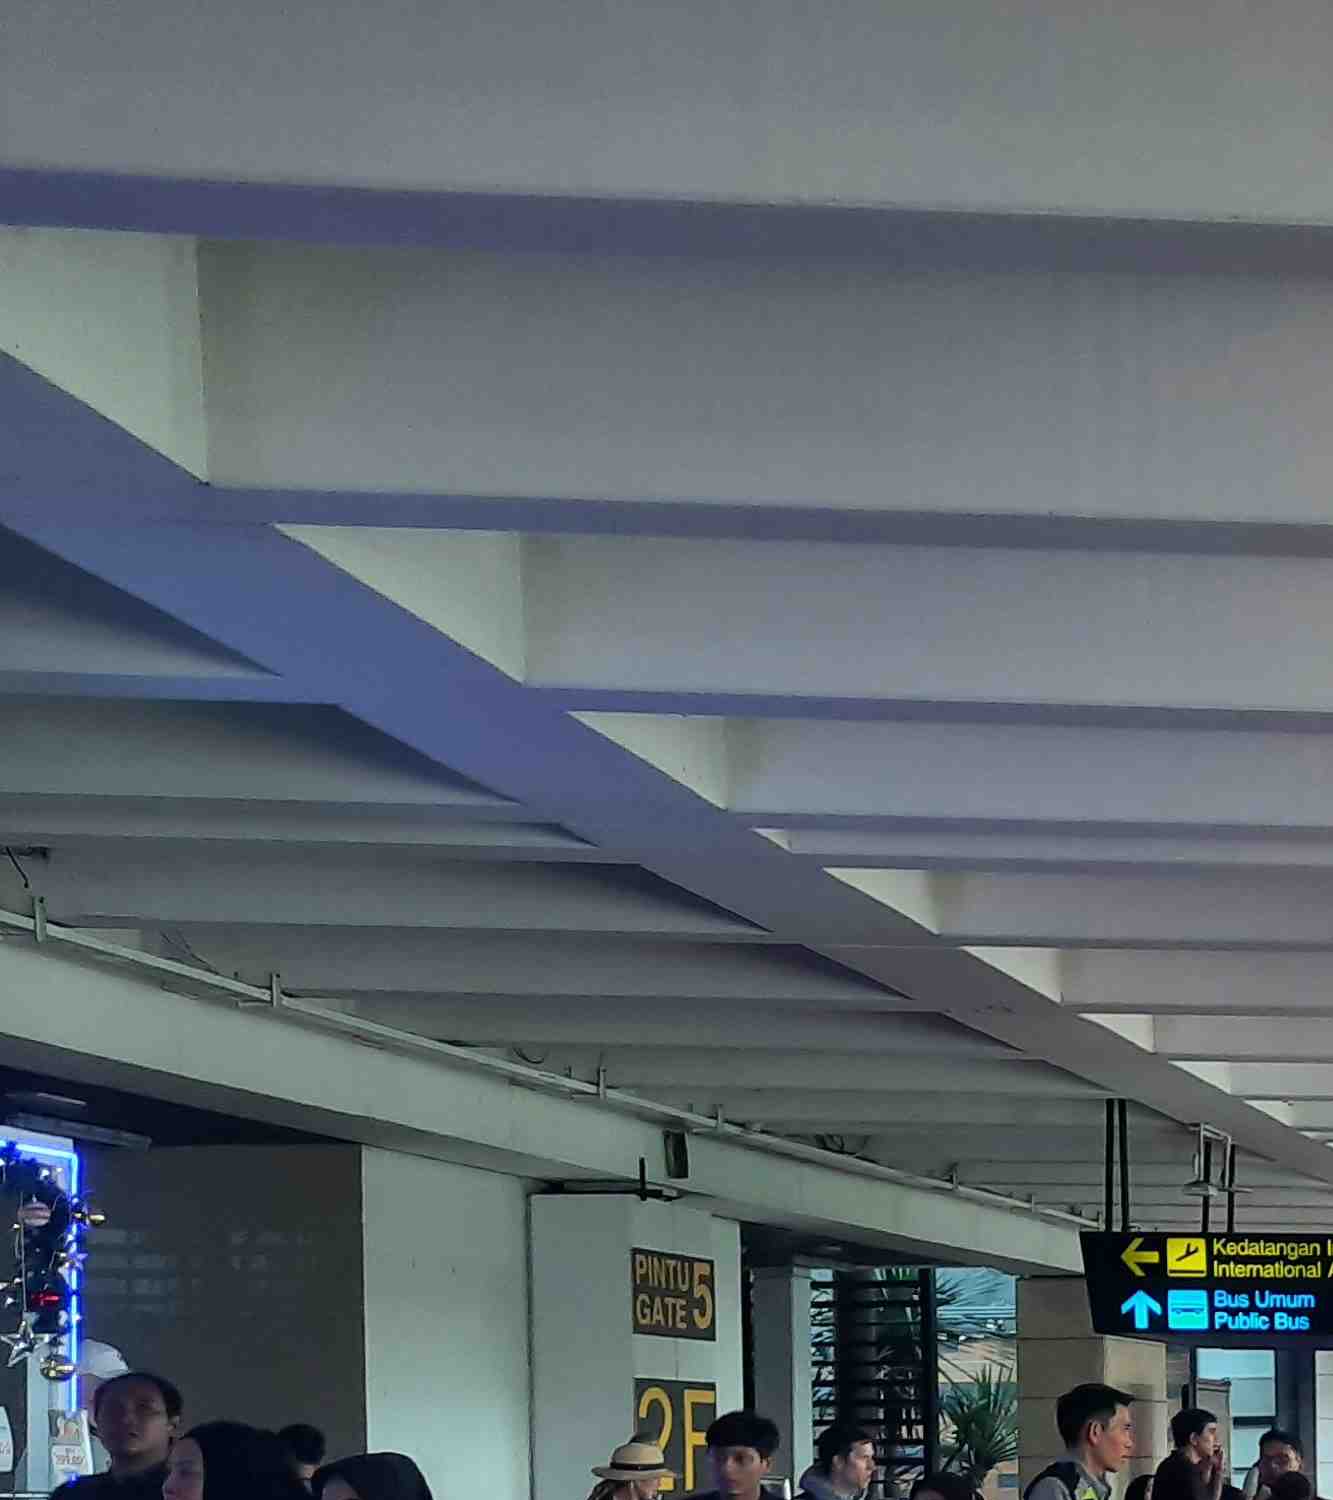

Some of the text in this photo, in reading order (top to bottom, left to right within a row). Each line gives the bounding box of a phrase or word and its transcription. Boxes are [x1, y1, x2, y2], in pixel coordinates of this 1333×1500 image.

[1213, 1239, 1320, 1259] Kedatangan
[635, 1254, 689, 1292] PINTU
[1213, 1261, 1321, 1279] International
[692, 1262, 713, 1330] 5
[1214, 1290, 1315, 1308] Bus Umum
[636, 1293, 687, 1329] GATE
[1214, 1312, 1310, 1330] Public Bus
[638, 1386, 715, 1491] 2F
